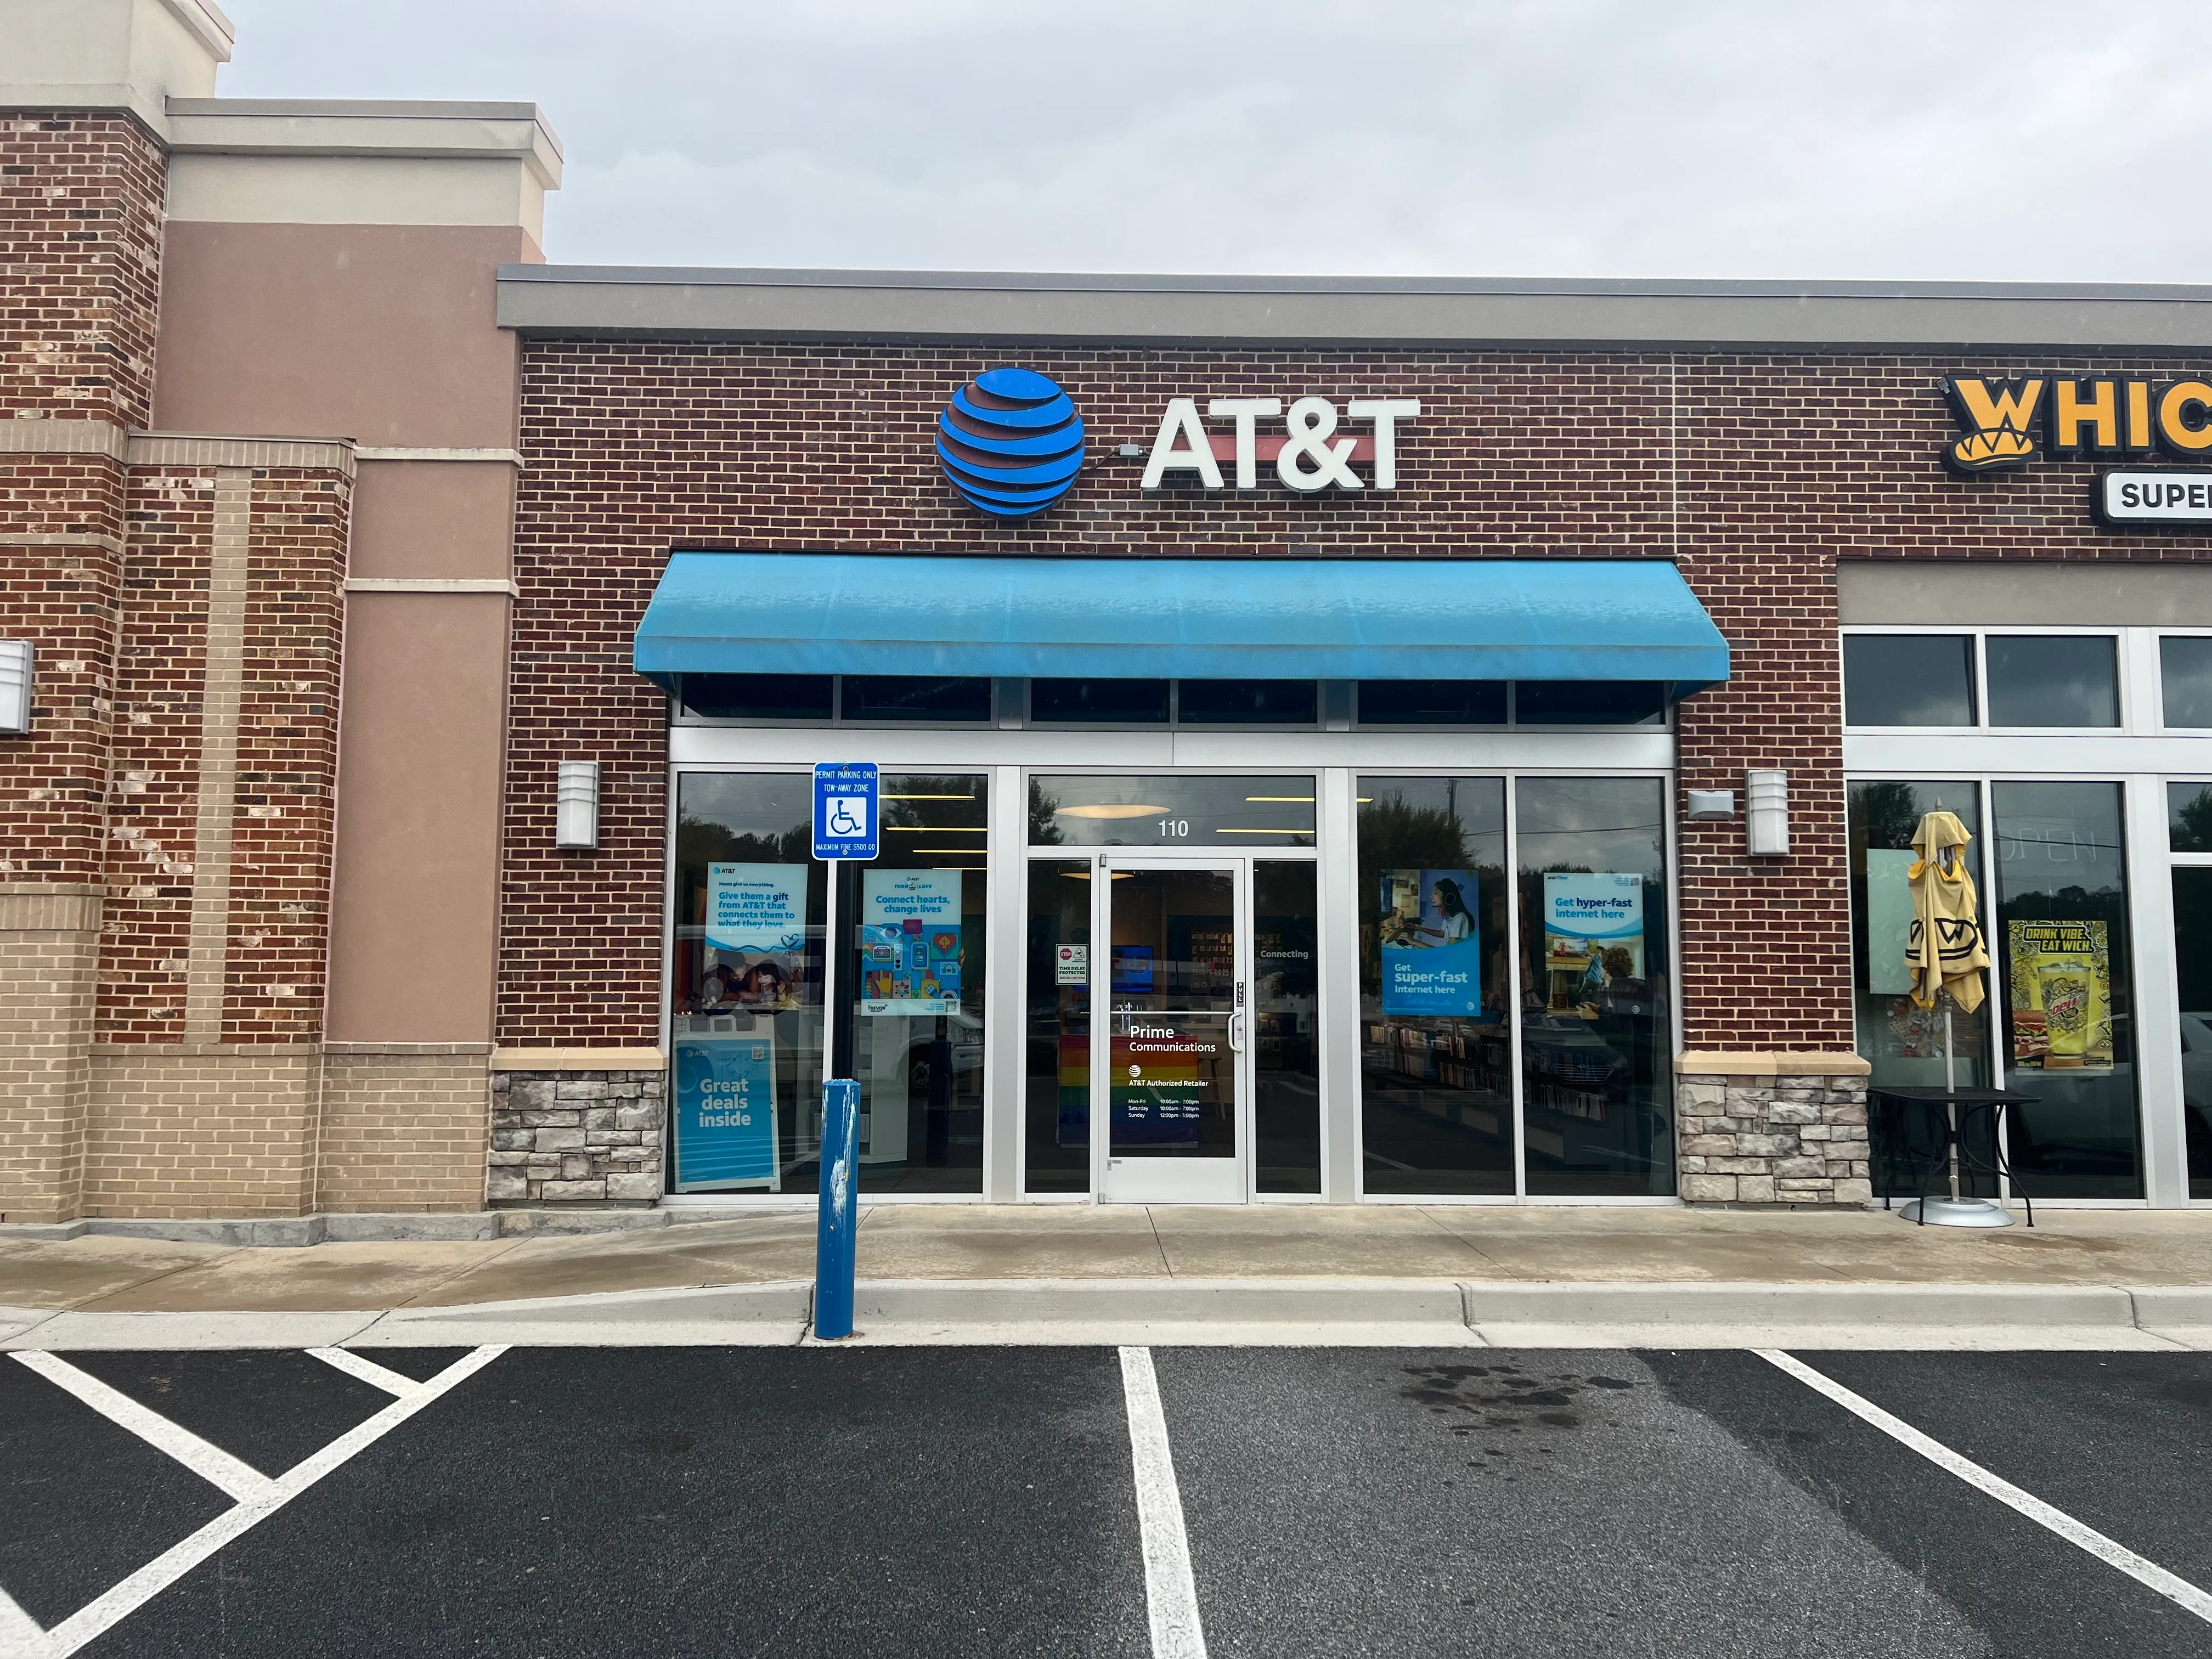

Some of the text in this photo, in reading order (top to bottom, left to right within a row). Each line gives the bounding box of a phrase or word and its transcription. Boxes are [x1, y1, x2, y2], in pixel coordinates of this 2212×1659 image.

[1140, 397, 1421, 493] AT&T
[2121, 483, 2212, 508] SUPE
[815, 771, 877, 779] PERMIT PARKING ONLY
[823, 784, 868, 792] TOW-AWAY ZONE
[1158, 820, 1189, 837] 110
[772, 893, 789, 902] gift
[876, 895, 950, 905] Connect hearts,
[1555, 898, 1633, 909] Get hyper-fast
[884, 905, 942, 915] change lives
[1556, 909, 1624, 918] internet here
[742, 919, 763, 929] they
[2025, 928, 2086, 939] DRINK VIBE.
[2041, 940, 2092, 951] EAT WICH.
[1260, 950, 1308, 960] Connecting
[1395, 970, 1468, 985] super-fast
[1395, 985, 1455, 994] internet here
[1130, 1025, 1174, 1039] Prime
[1129, 1042, 1216, 1052] Communications
[700, 1079, 749, 1093] Great
[701, 1093, 748, 1110] deals
[699, 1111, 751, 1127] inside
